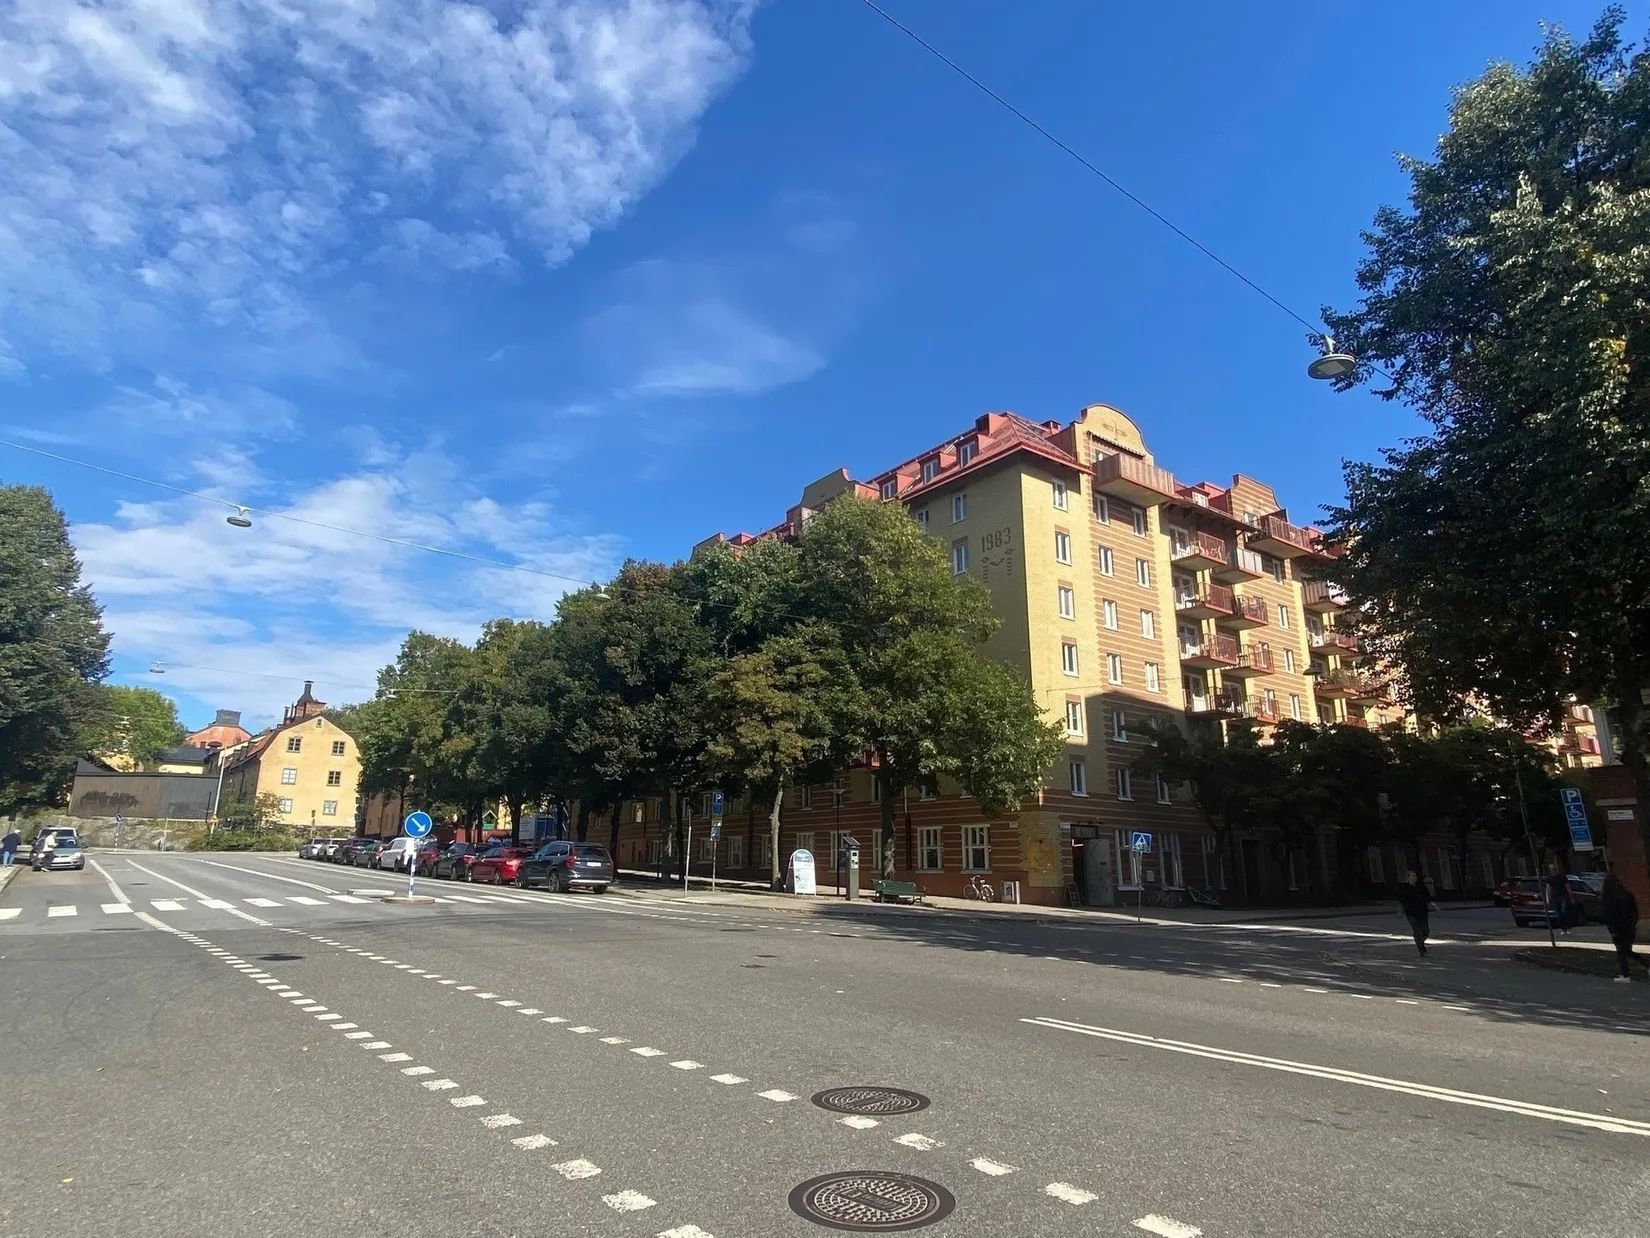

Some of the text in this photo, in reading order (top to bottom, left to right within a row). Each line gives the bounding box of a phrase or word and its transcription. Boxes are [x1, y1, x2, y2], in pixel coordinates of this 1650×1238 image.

[981, 526, 1012, 553] 1983
[715, 793, 722, 803] P
[1565, 790, 1577, 802] P
